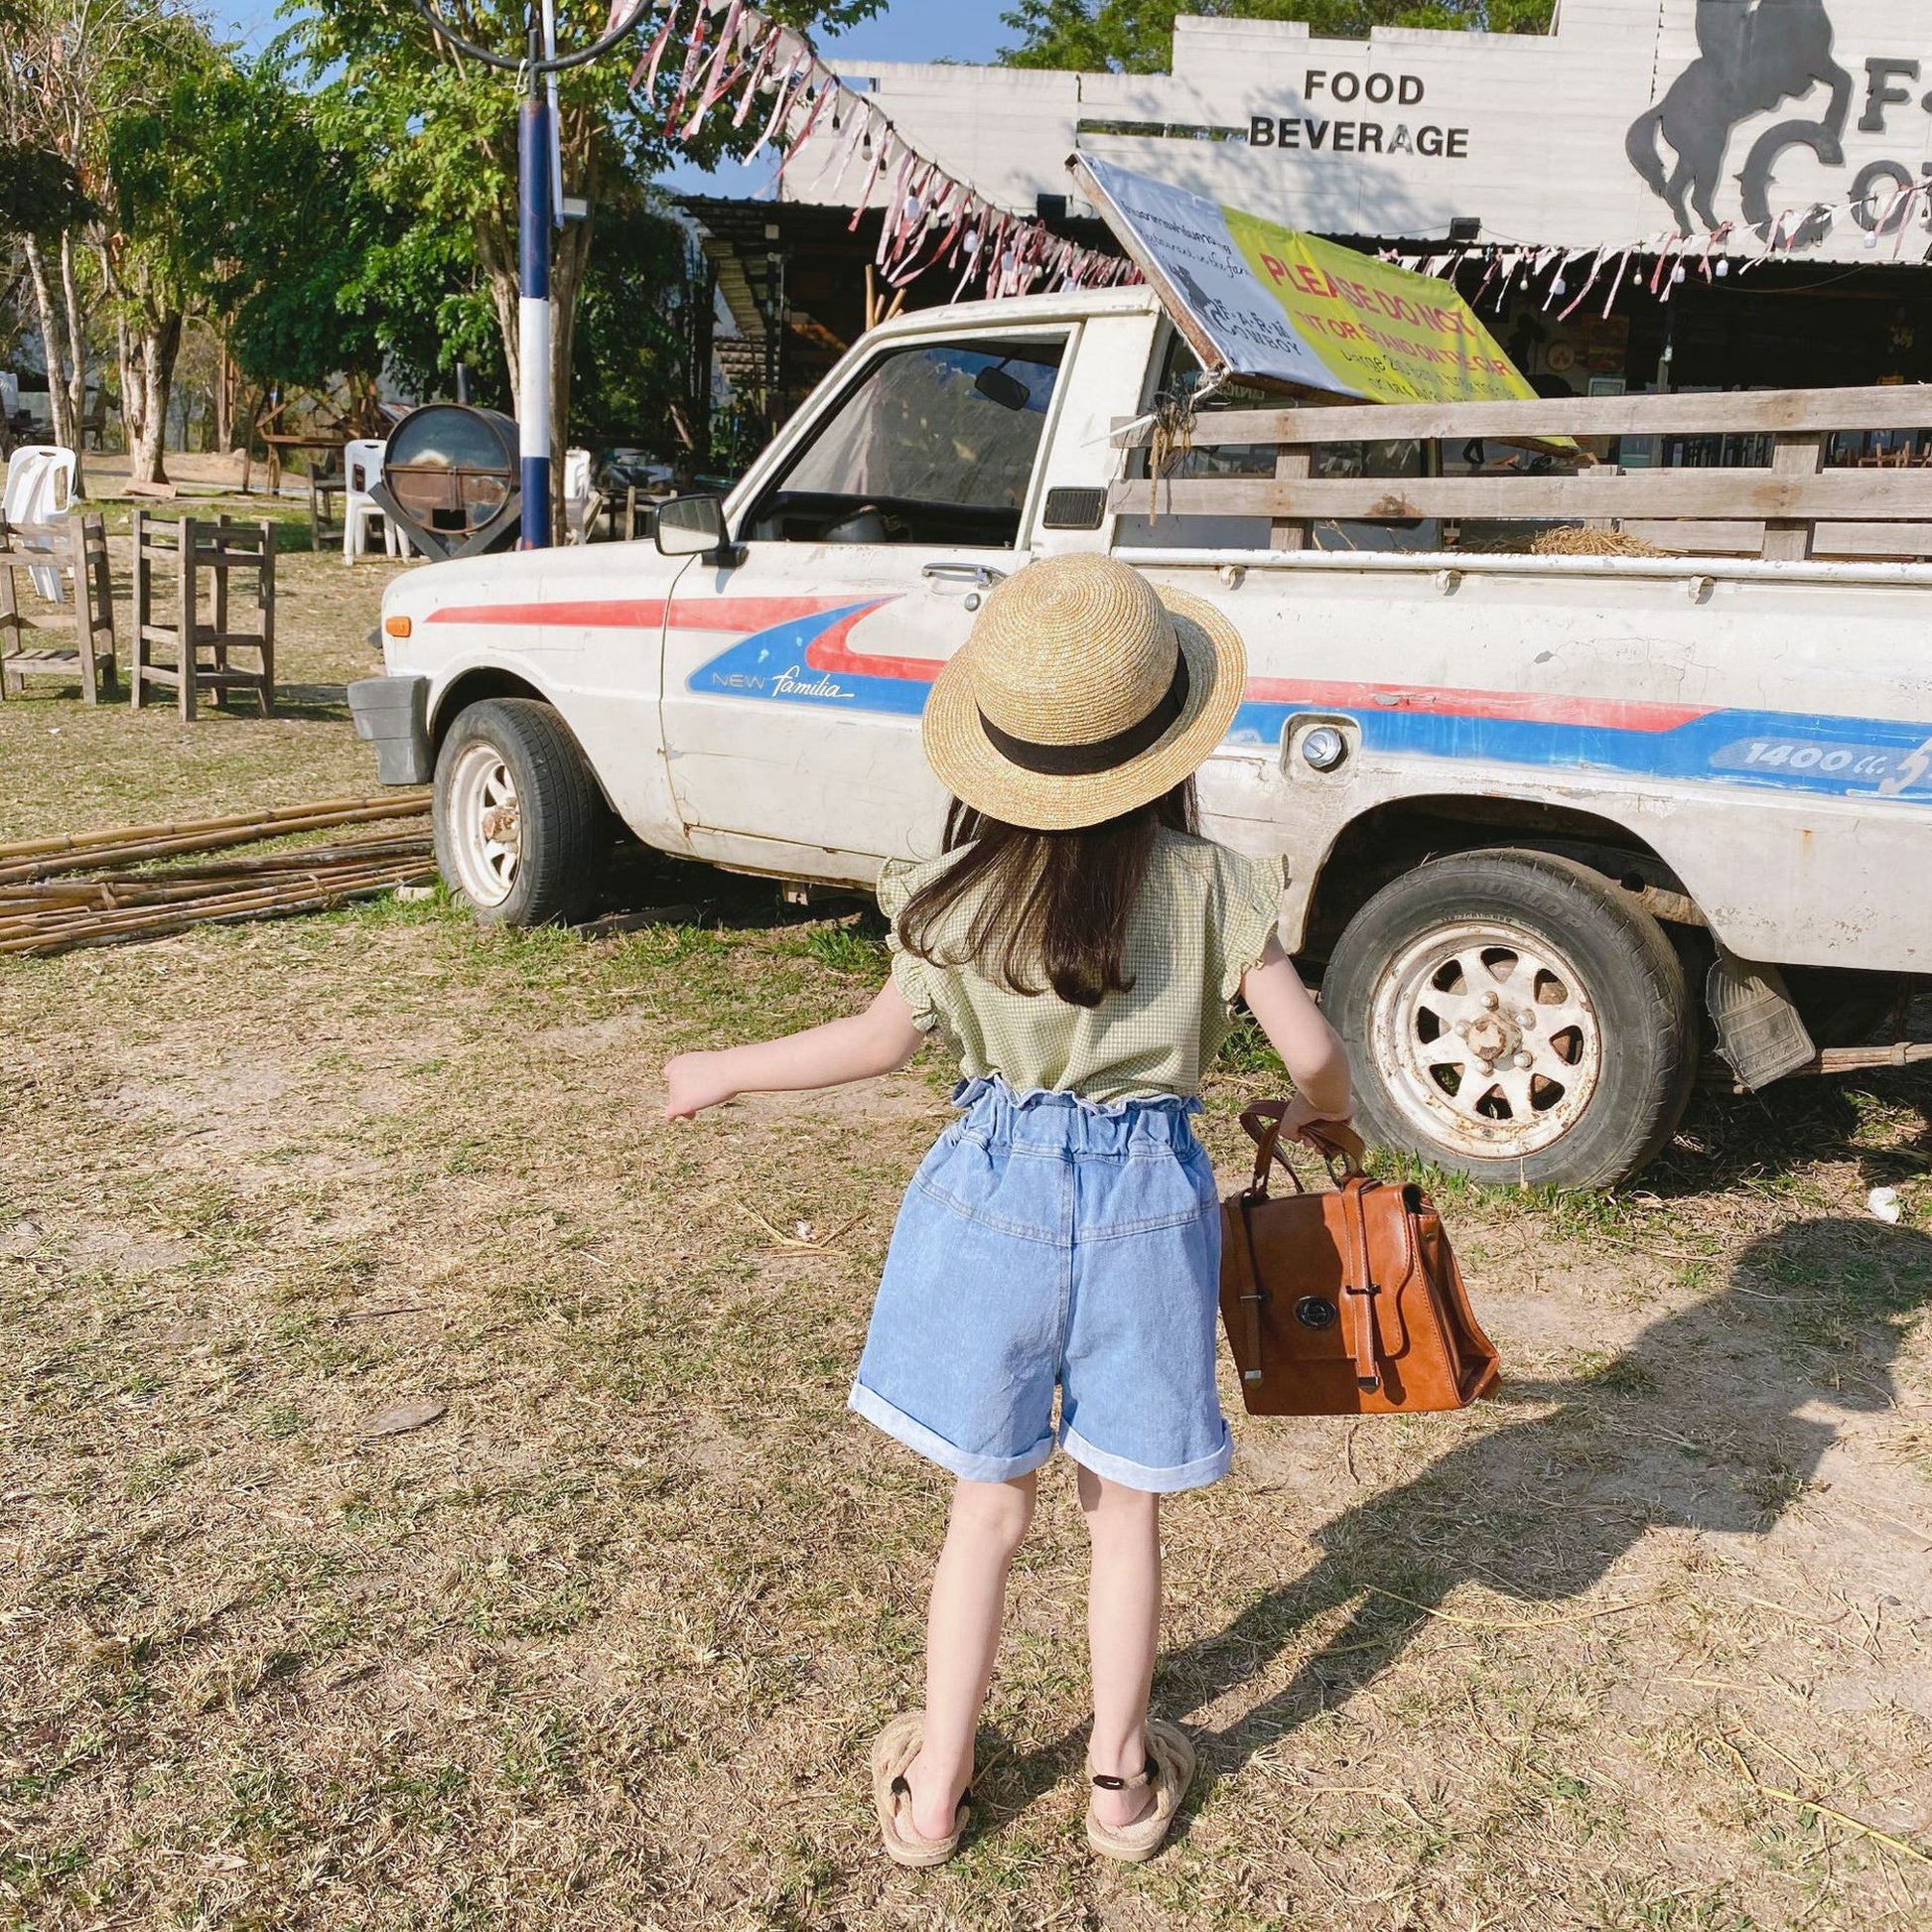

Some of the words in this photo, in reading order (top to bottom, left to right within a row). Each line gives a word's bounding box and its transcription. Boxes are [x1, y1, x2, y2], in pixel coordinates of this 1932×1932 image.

[1304, 69, 1426, 105] FOOD
[1249, 116, 1469, 158] BEVERAGE
[1260, 252, 1381, 315] PLEASE
[1374, 288, 1421, 327] DO
[1415, 302, 1475, 338] NOT
[1210, 308, 1303, 355] COWBOY
[1327, 319, 1364, 341] OR
[1359, 323, 1418, 357] STAND
[1415, 343, 1446, 364] ON
[1472, 355, 1514, 376] CAR
[713, 673, 766, 690] NEW
[771, 665, 856, 698] familia
